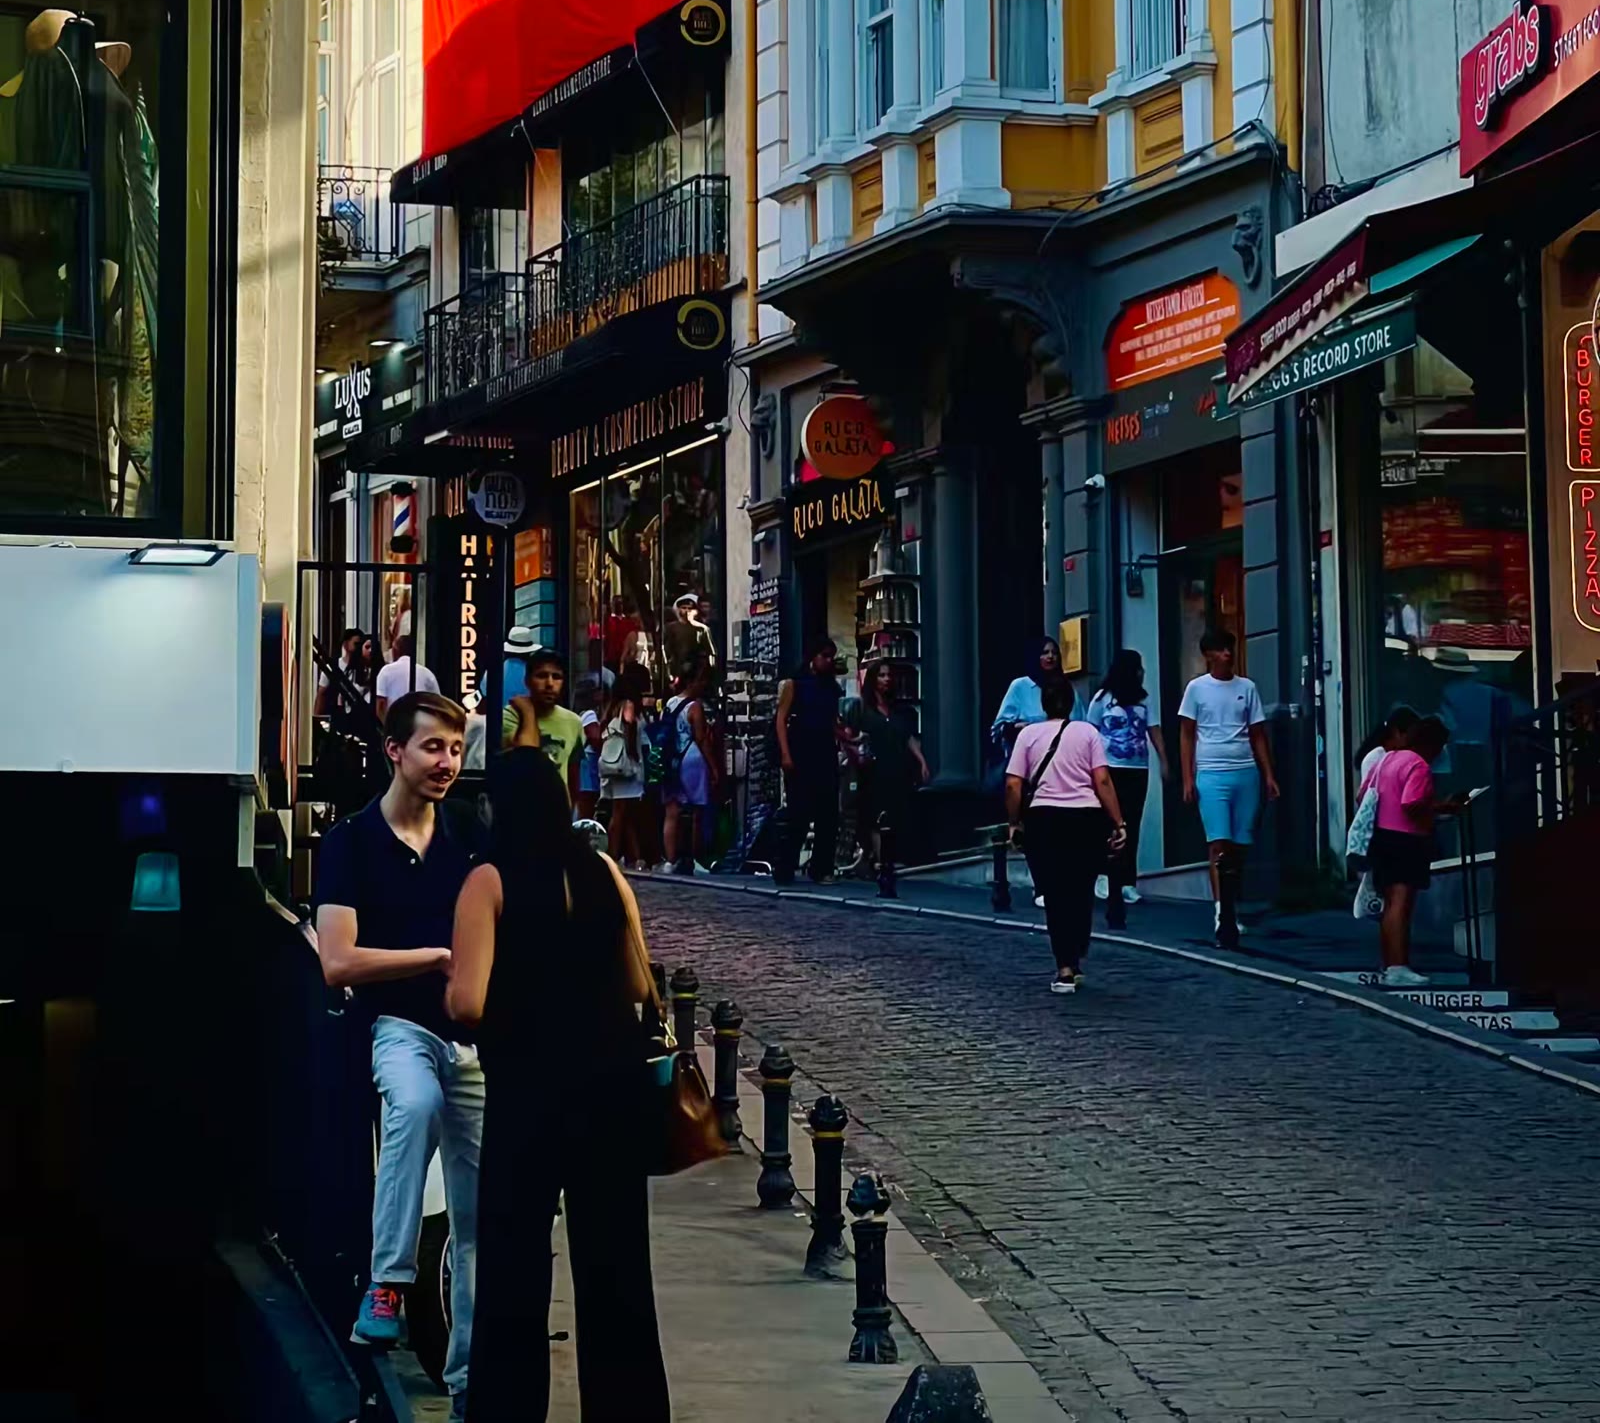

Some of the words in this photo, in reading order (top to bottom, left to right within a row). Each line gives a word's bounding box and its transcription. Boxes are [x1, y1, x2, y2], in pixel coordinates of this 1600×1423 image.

[1474, 1, 1540, 126] grabs
[1303, 342, 1350, 378] RECORD
[1354, 326, 1392, 359] STORE
[335, 364, 371, 415] LUXUS
[1577, 349, 1594, 466] BURGER
[551, 426, 589, 478] BEAUTY
[603, 394, 665, 456] COSMETICS
[668, 377, 704, 430] STORE
[814, 440, 874, 456] GALATA
[823, 421, 865, 439] RICO
[793, 499, 824, 540] RICO
[832, 479, 886, 524] GALATA
[1580, 487, 1600, 598] PIZZA
